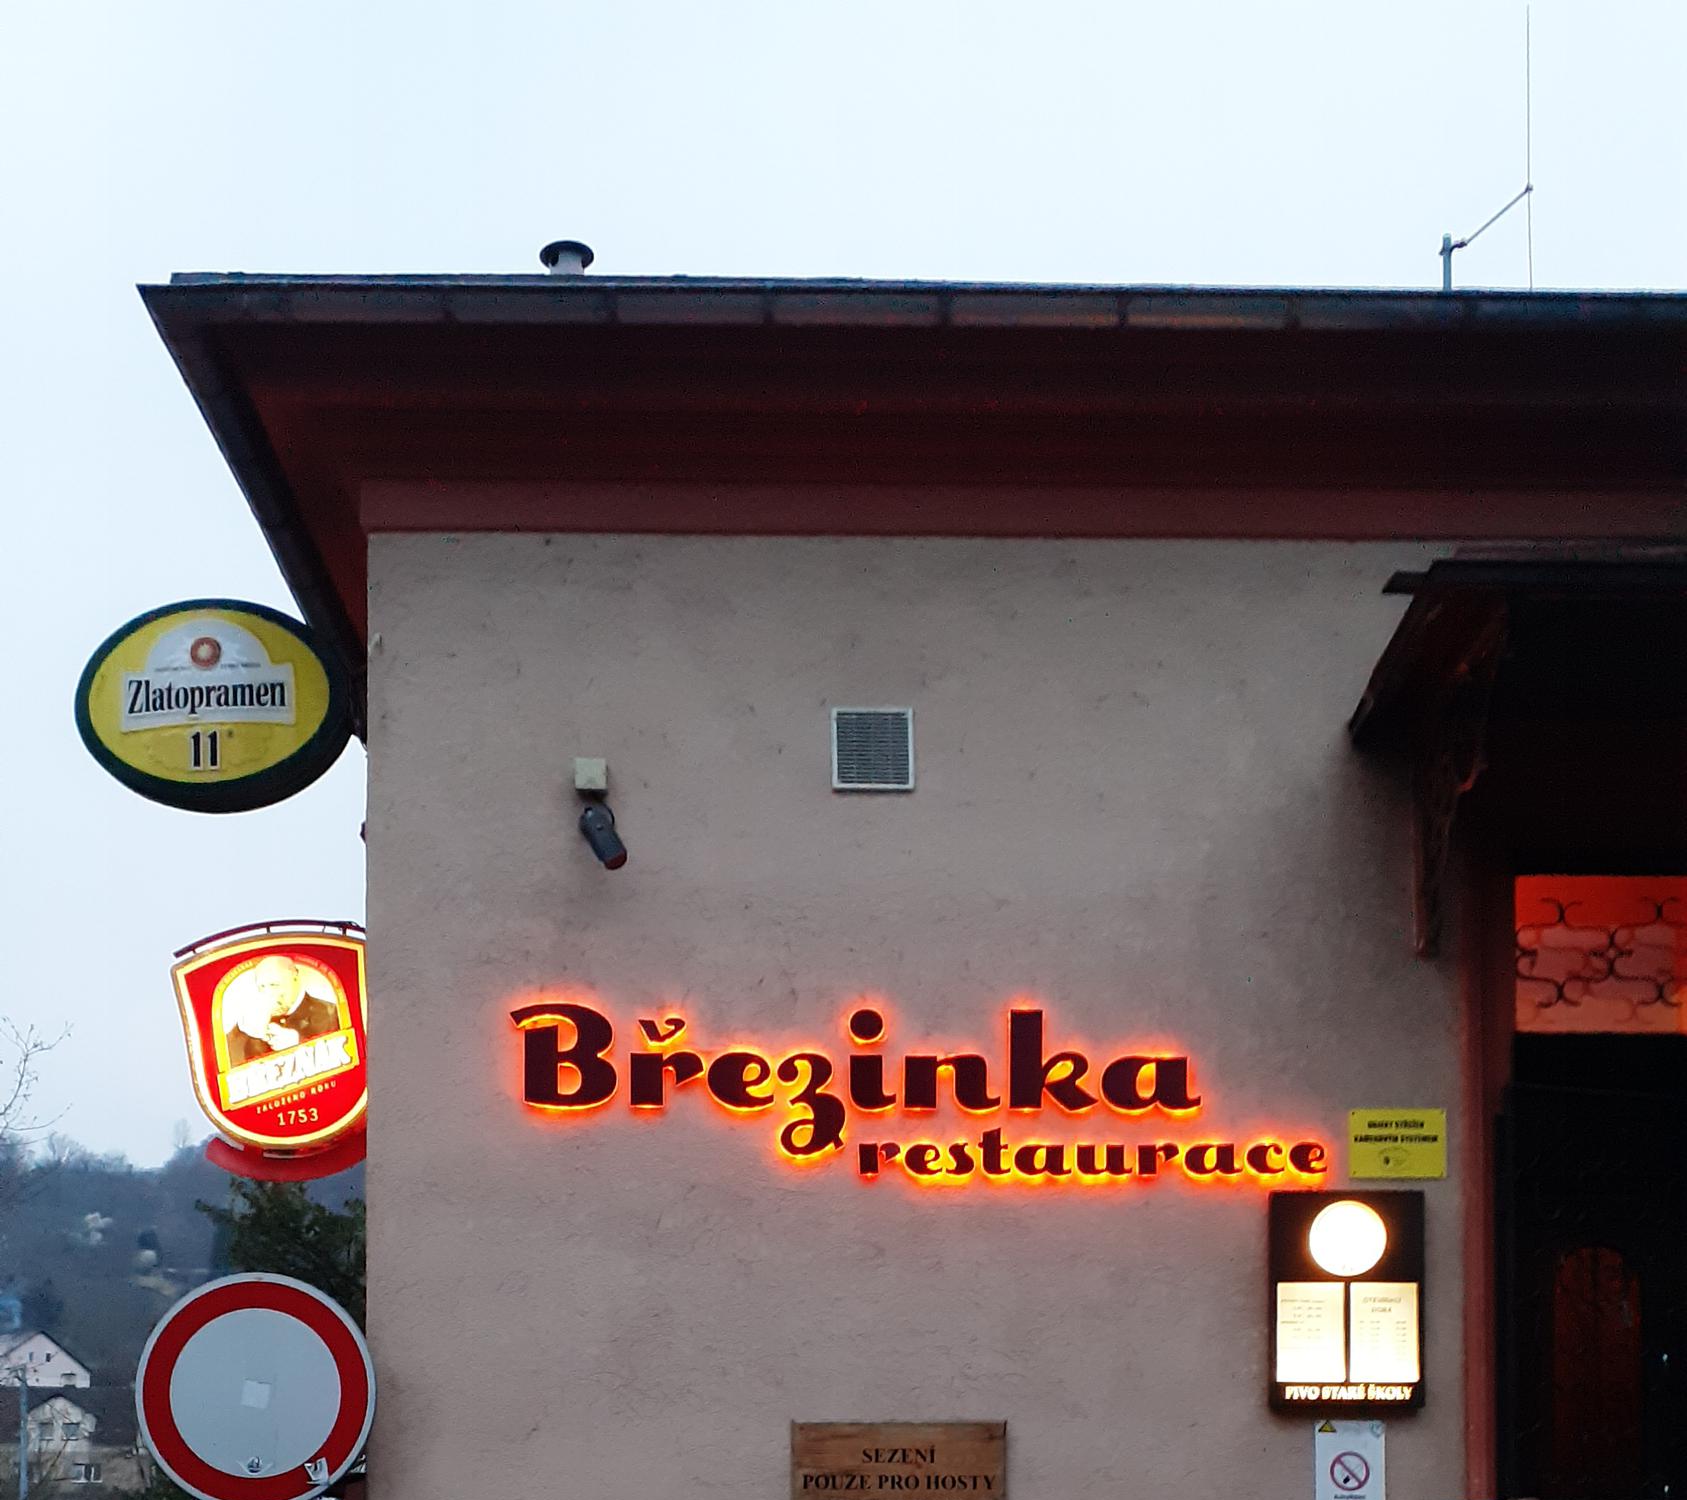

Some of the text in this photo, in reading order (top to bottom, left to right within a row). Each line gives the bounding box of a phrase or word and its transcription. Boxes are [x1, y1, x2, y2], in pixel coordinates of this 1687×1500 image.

[128, 679, 287, 715] Zlatopramen
[189, 730, 219, 768] 11
[509, 1002, 1202, 1159] Březinka
[276, 1107, 320, 1127] 1753
[857, 1128, 1328, 1177] restaurace
[1367, 1383, 1413, 1400] ŠKOLY
[862, 1445, 936, 1464] SEZENÍ
[802, 1474, 996, 1490] POUZE PRO HOSTY
